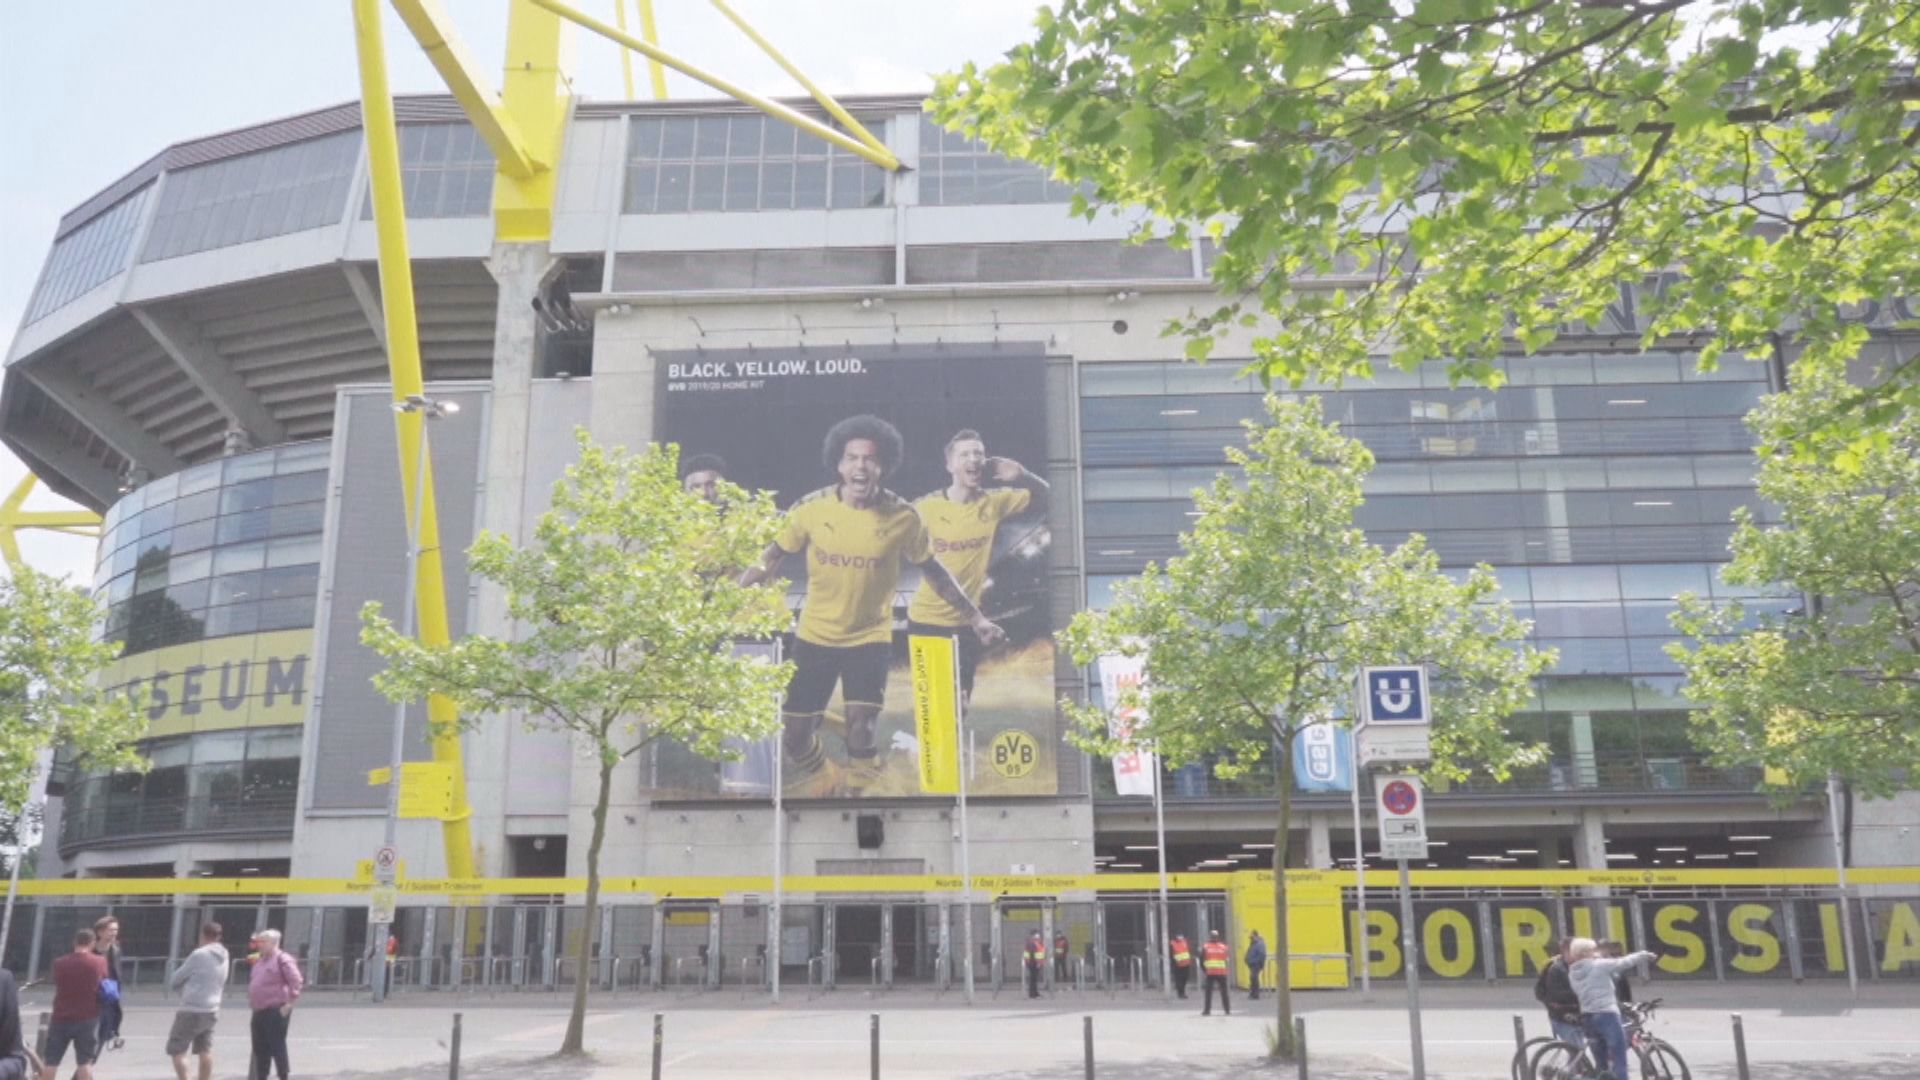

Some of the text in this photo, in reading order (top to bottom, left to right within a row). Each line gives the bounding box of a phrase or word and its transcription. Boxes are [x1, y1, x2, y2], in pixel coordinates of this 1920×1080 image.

[668, 359, 867, 378] BLACK. YELLOW. LOUD.
[1378, 677, 1412, 714] U
[995, 735, 1033, 765] BVB
[1006, 764, 1021, 776] 09
